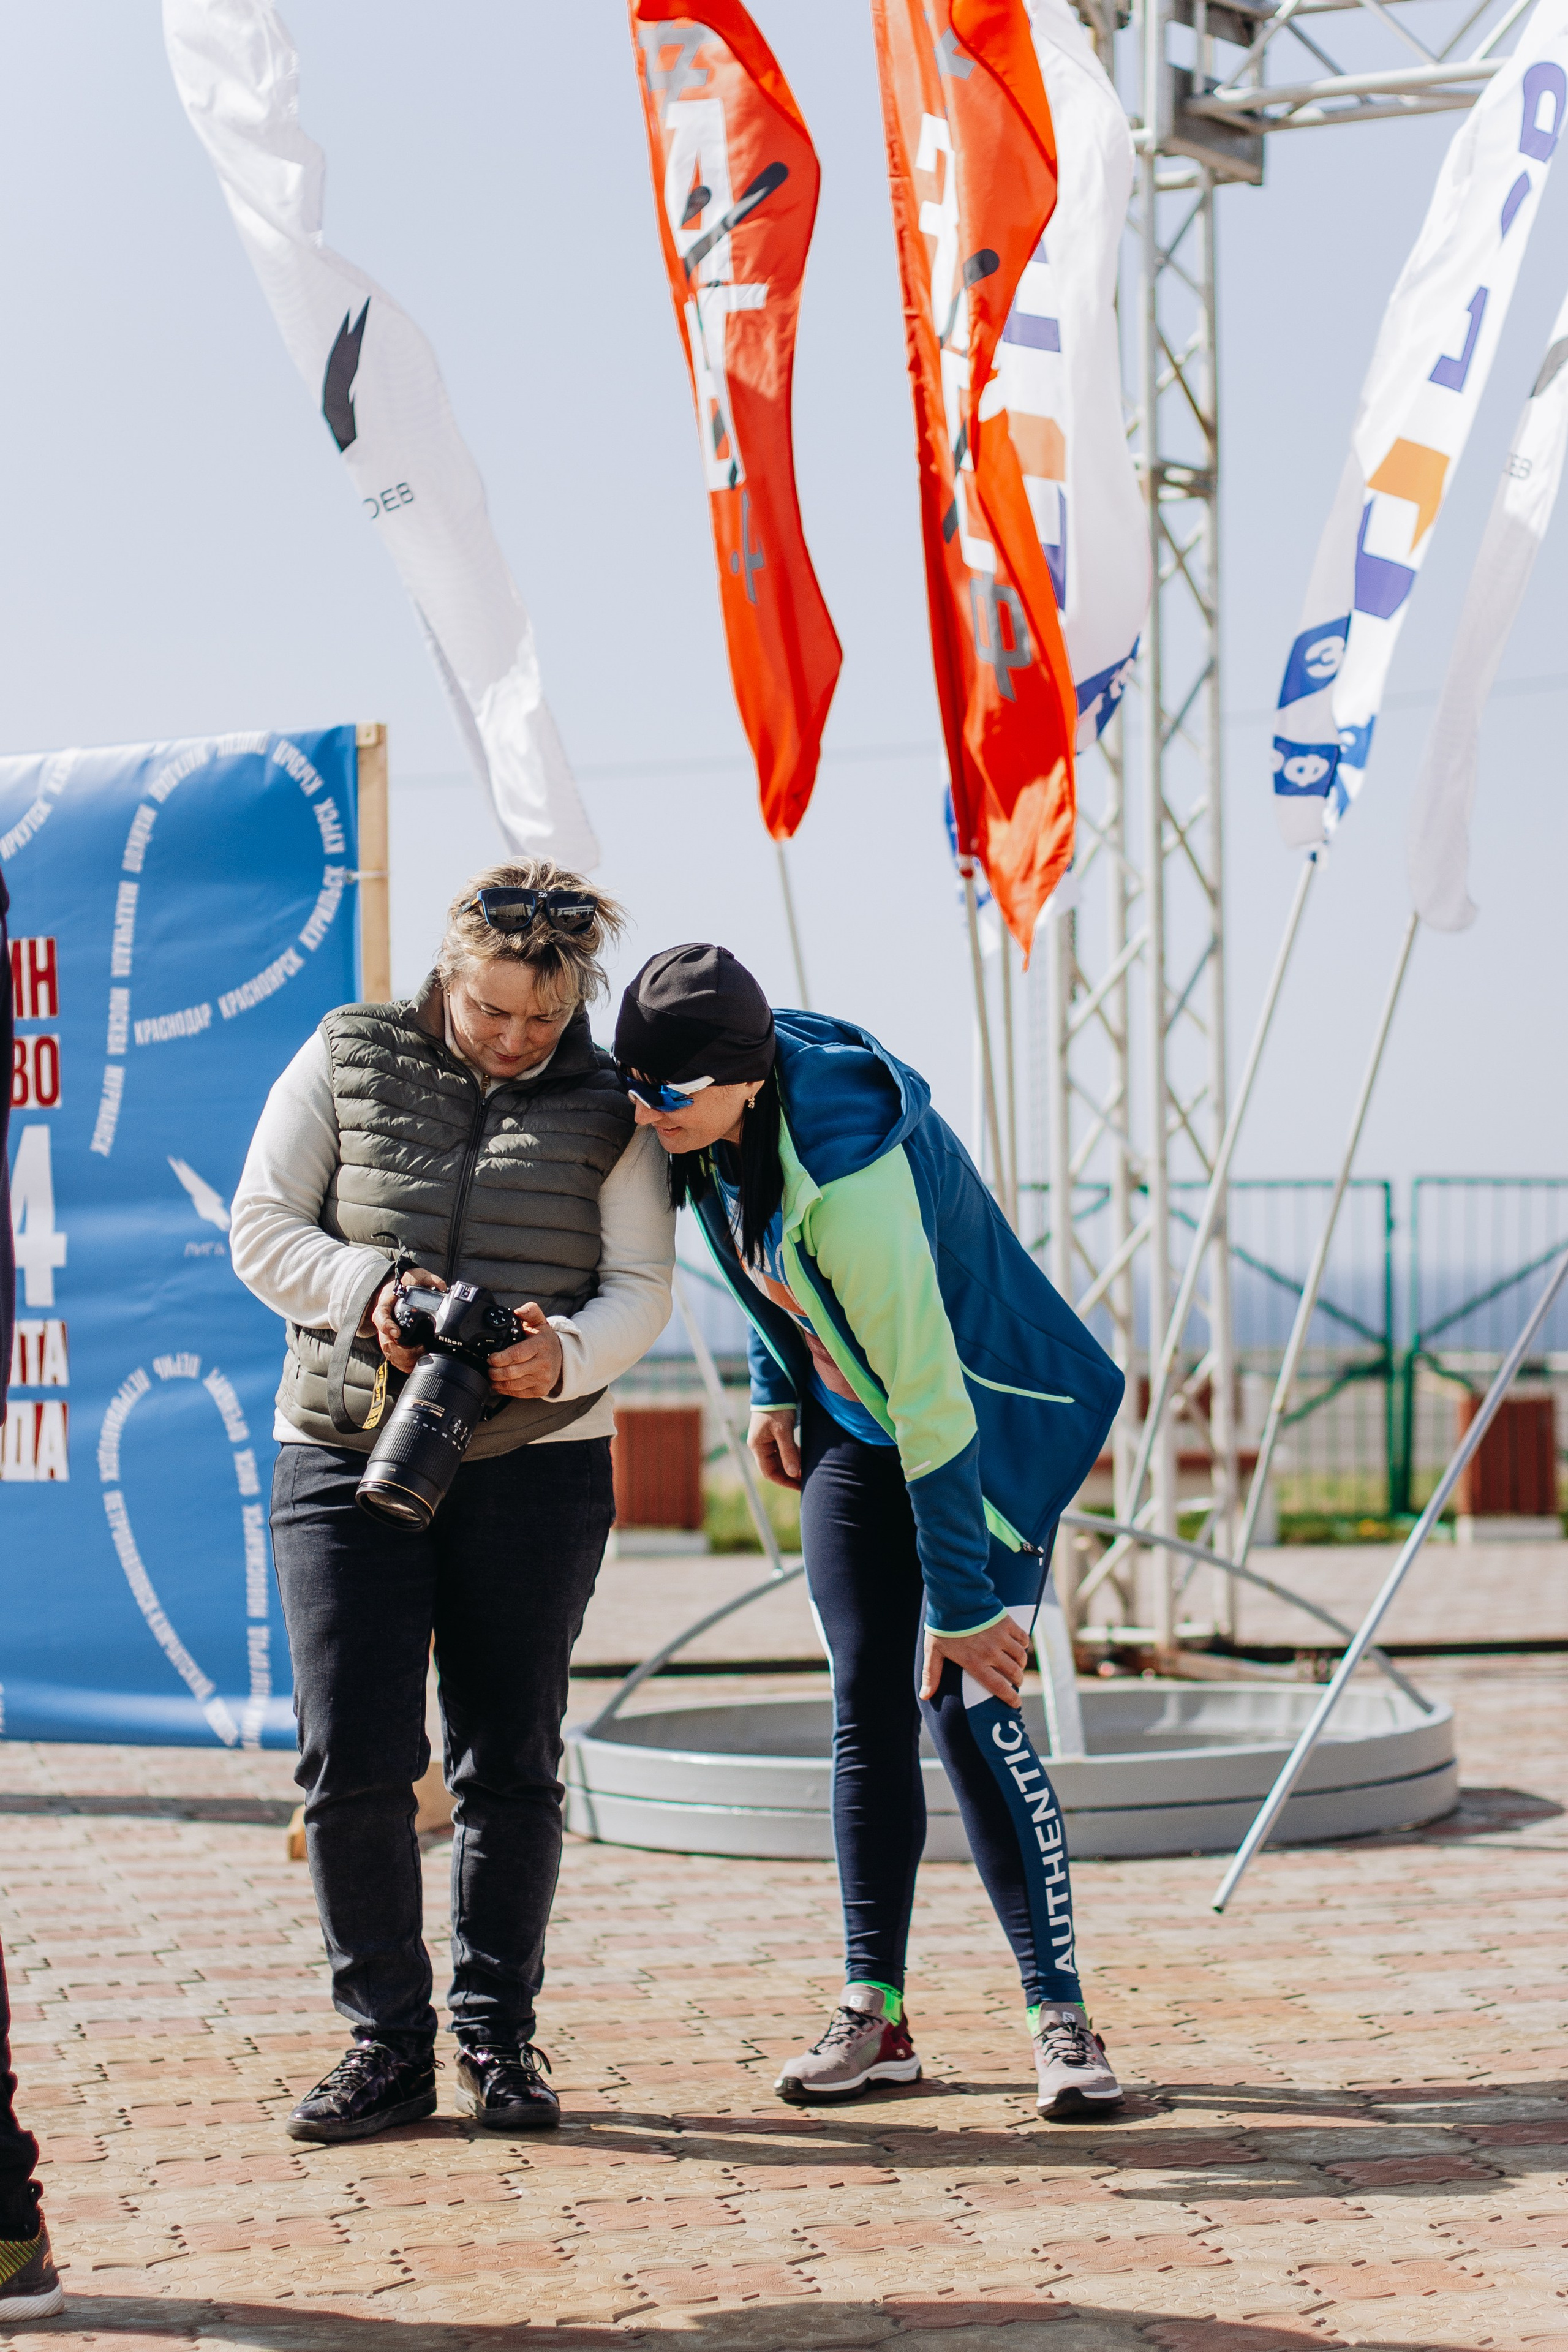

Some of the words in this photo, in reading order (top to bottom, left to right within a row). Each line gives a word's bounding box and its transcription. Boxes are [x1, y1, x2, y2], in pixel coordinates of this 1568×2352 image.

[272, 739, 323, 796] КЫЗЫЛ
[313, 797, 345, 854] КУРСК
[299, 864, 345, 951] КУРИЛЬСК
[217, 946, 305, 1020] КРАСНОЯРСК
[134, 1002, 213, 1044] КРАСНОДАР
[439, 1336, 462, 1346] Nikon
[992, 1720, 1077, 1973] AUTHENTIC
